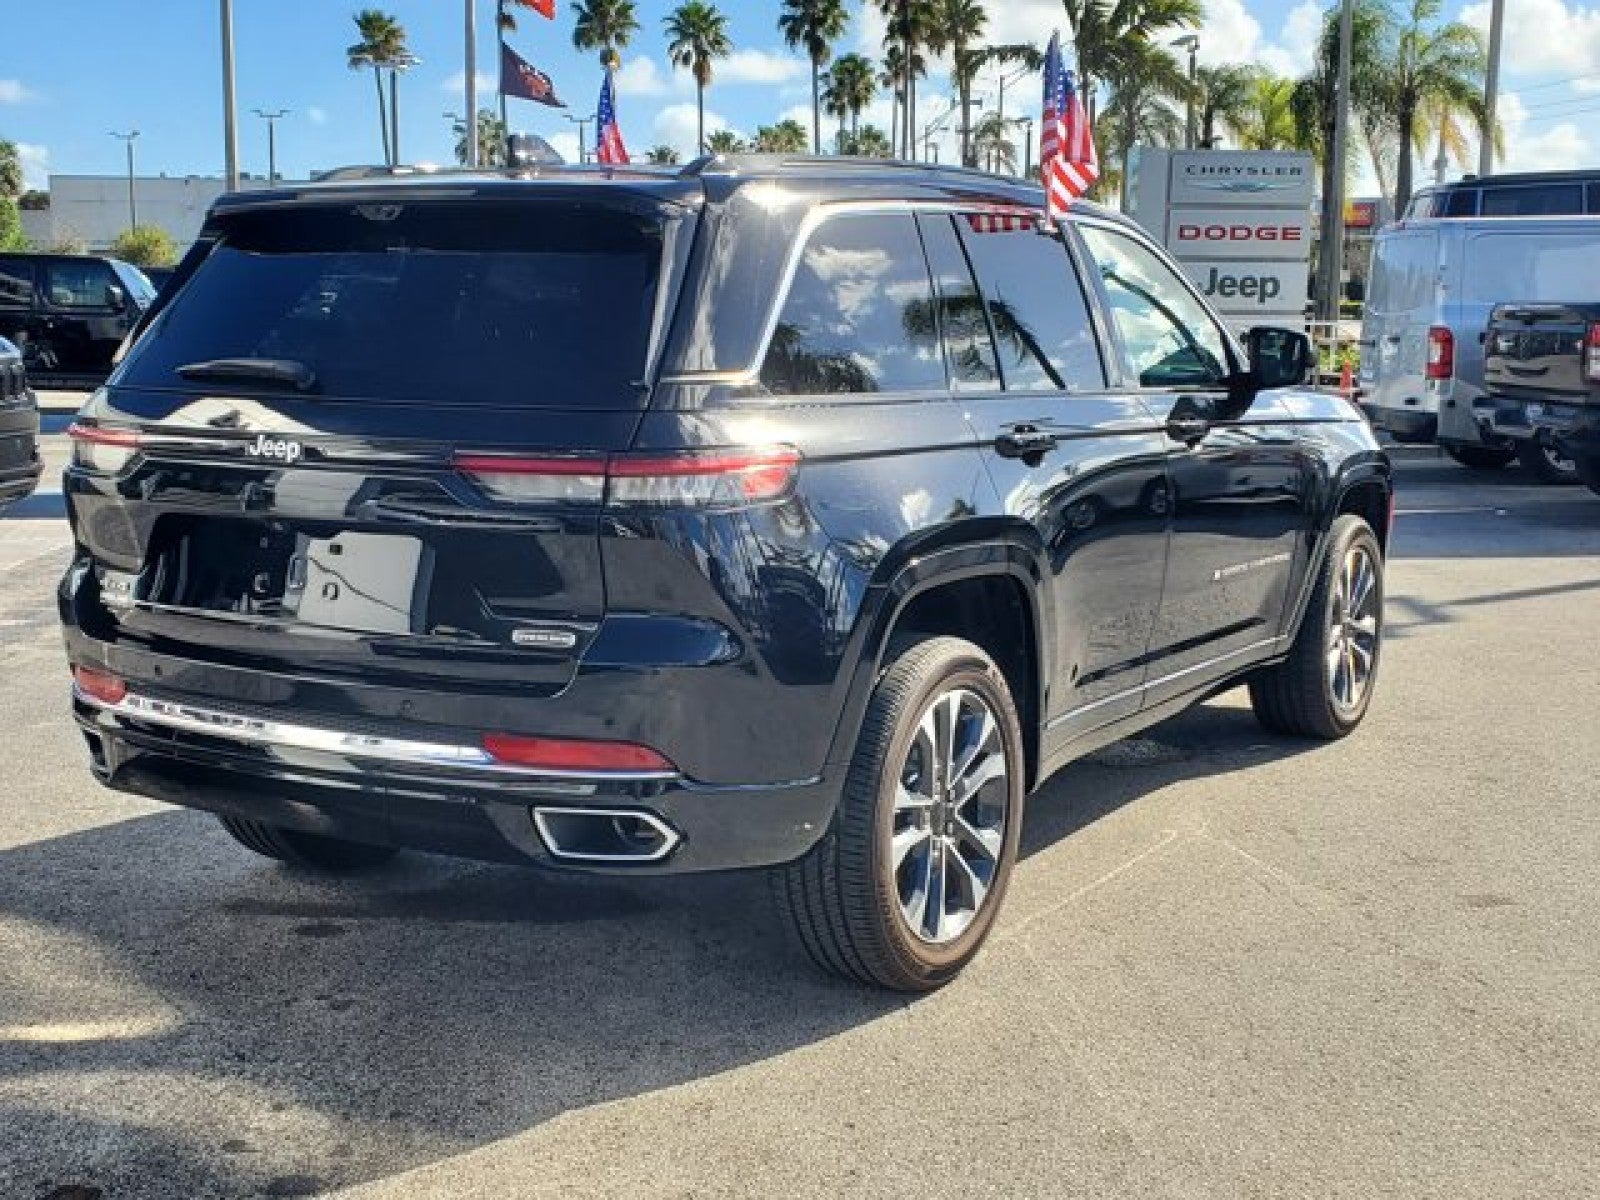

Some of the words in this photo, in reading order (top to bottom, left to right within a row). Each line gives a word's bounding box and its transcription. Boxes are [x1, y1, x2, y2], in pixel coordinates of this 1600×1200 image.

[1187, 165, 1302, 176] CHRYSLER
[1180, 225, 1301, 240] DODGE
[1204, 268, 1280, 303] Jeep
[249, 434, 301, 462] Jeep
